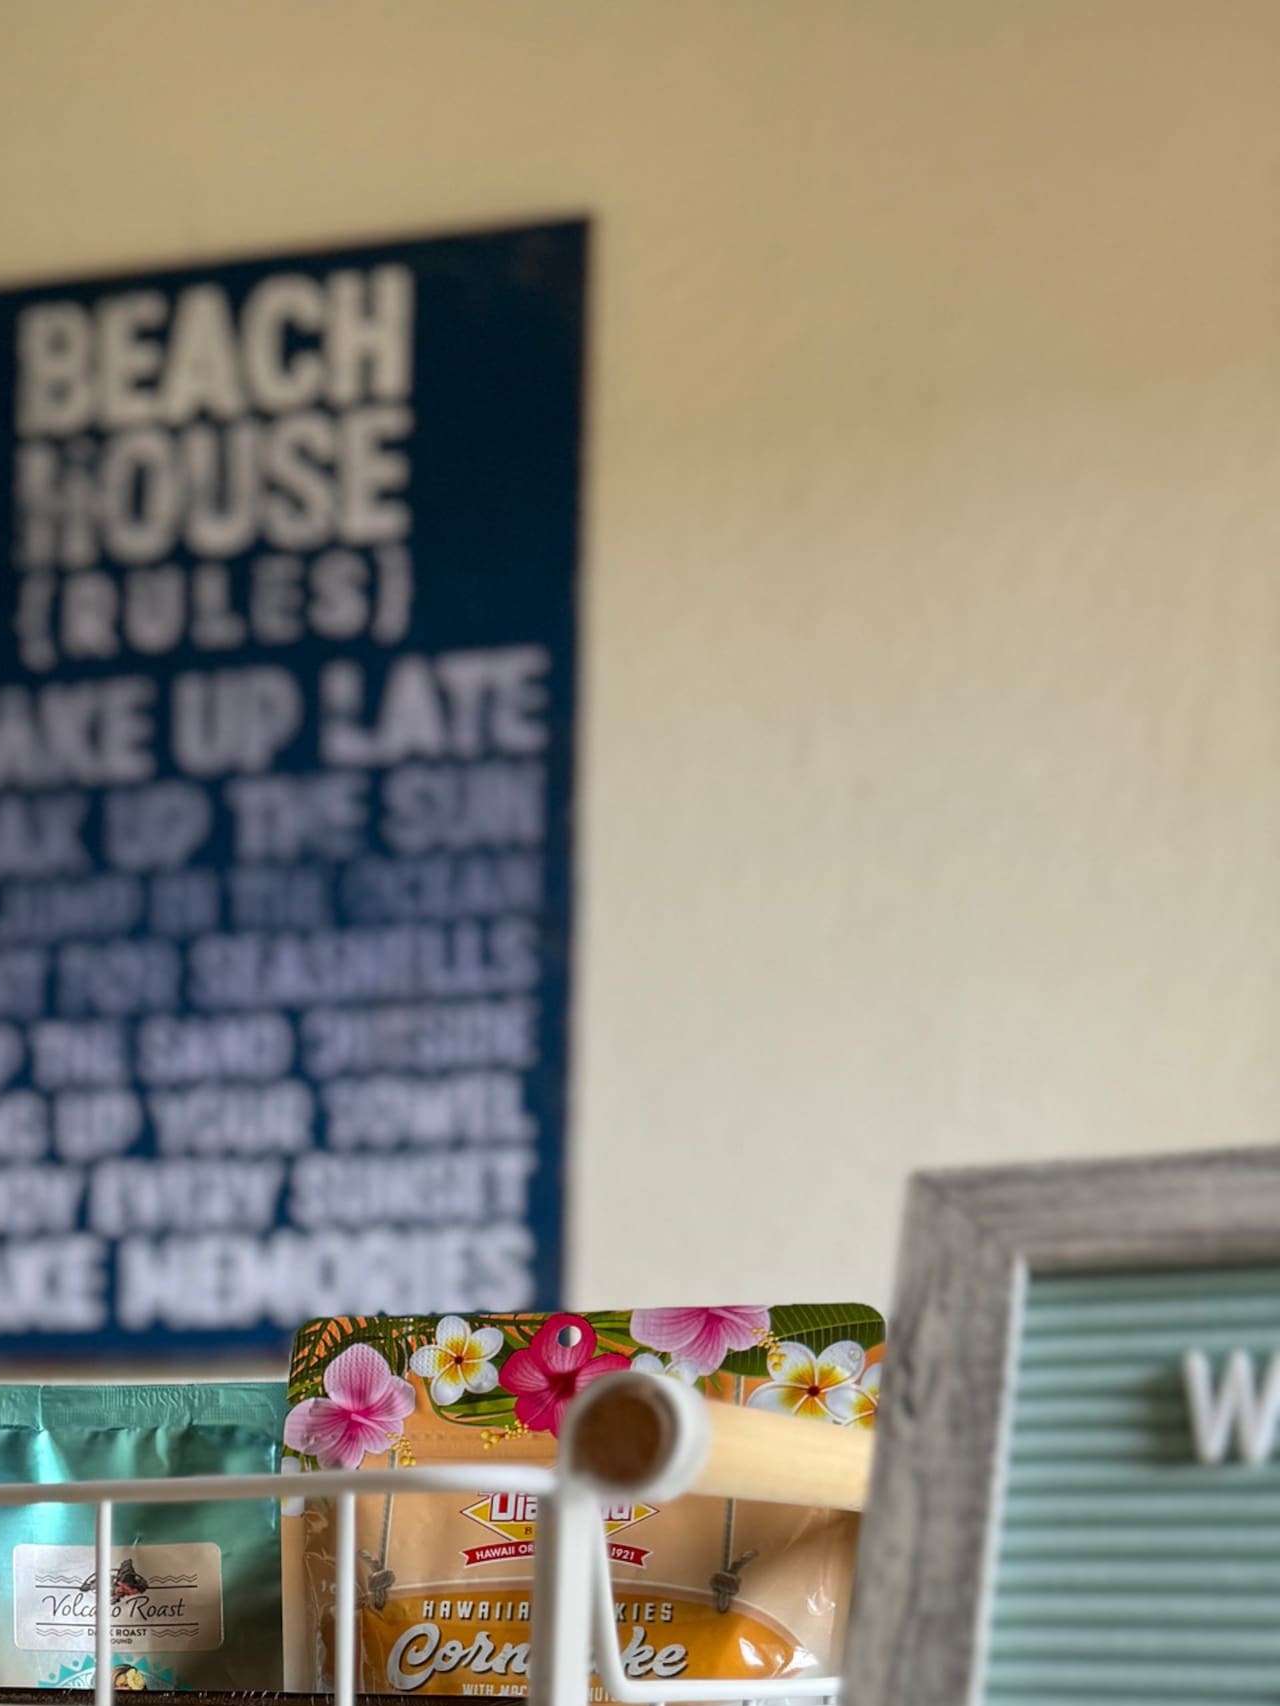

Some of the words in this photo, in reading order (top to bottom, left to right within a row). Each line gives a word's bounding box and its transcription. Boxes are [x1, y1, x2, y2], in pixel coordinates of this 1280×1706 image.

[18, 264, 413, 438] BEACH
[16, 407, 412, 569] HOUSE
[18, 544, 412, 670] (RULES)
[172, 666, 302, 775] UP
[320, 646, 549, 764] LATE
[105, 782, 212, 871] UP
[228, 772, 369, 862] THE
[382, 762, 546, 853] SUN
[137, 1010, 294, 1084] SAND
[56, 1086, 142, 1161] UP
[151, 1079, 315, 1156] YOUR
[89, 1154, 284, 1235] EVERY
[117, 1223, 536, 1331] MEMORIES
[476, 1545, 516, 1560] HAWAII
[611, 1547, 635, 1561] 1921
[42, 1593, 121, 1617] Volcao
[126, 1595, 185, 1620] Roast
[116, 1628, 147, 1637] ROAST
[422, 1600, 532, 1620] HAWAIIA
[462, 1683, 494, 1696] WITH
